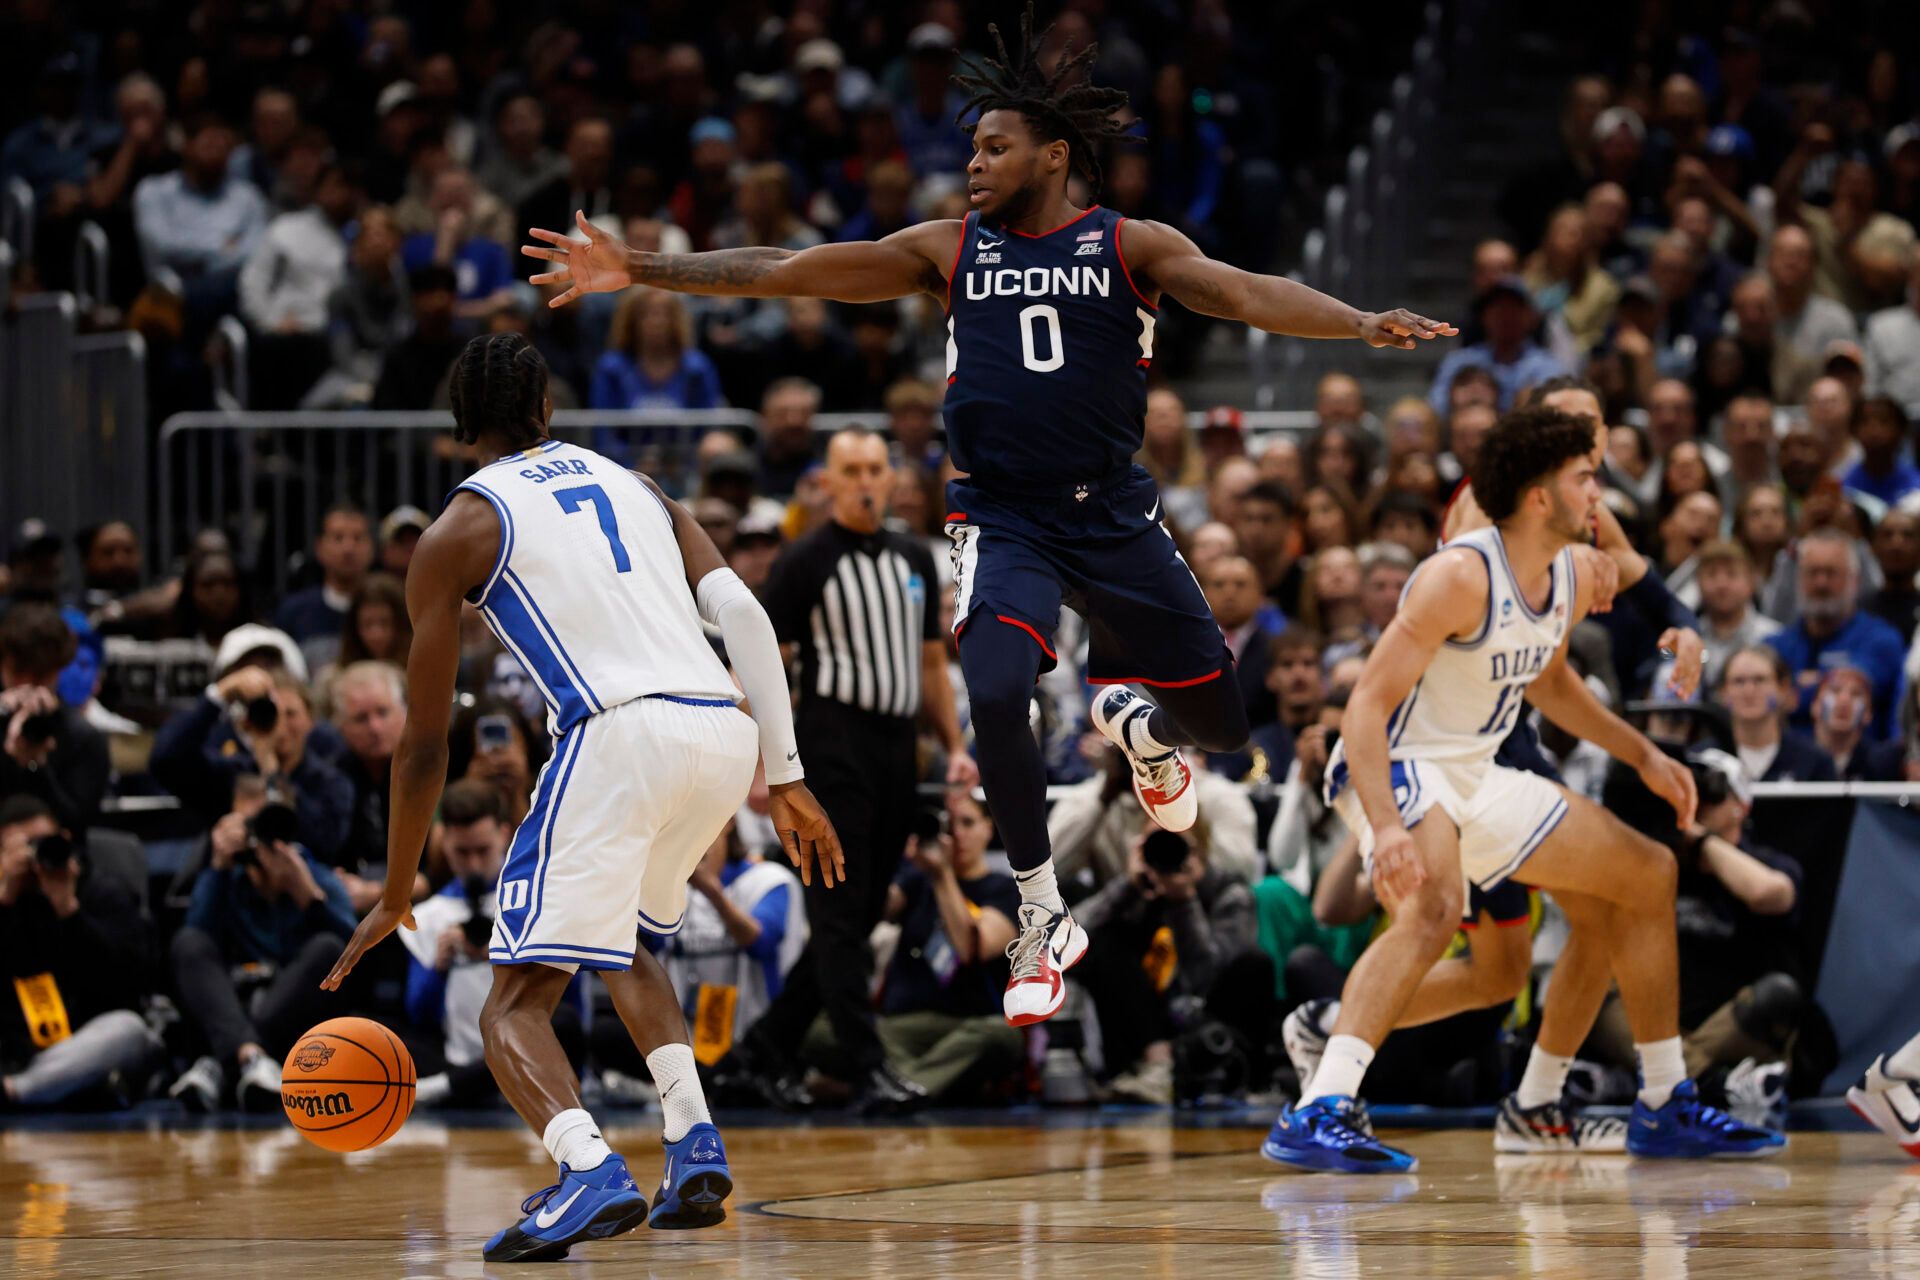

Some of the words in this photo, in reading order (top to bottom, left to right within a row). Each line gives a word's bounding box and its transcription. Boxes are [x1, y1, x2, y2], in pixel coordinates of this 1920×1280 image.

[975, 257, 1002, 265] CHANGE
[966, 266, 1110, 300] UCONN
[1019, 304, 1065, 373] 0
[519, 458, 594, 484] SARR
[551, 483, 632, 574] 7
[1490, 646, 1556, 681] DUK
[501, 879, 529, 912] D
[282, 1091, 354, 1117] Wilson
